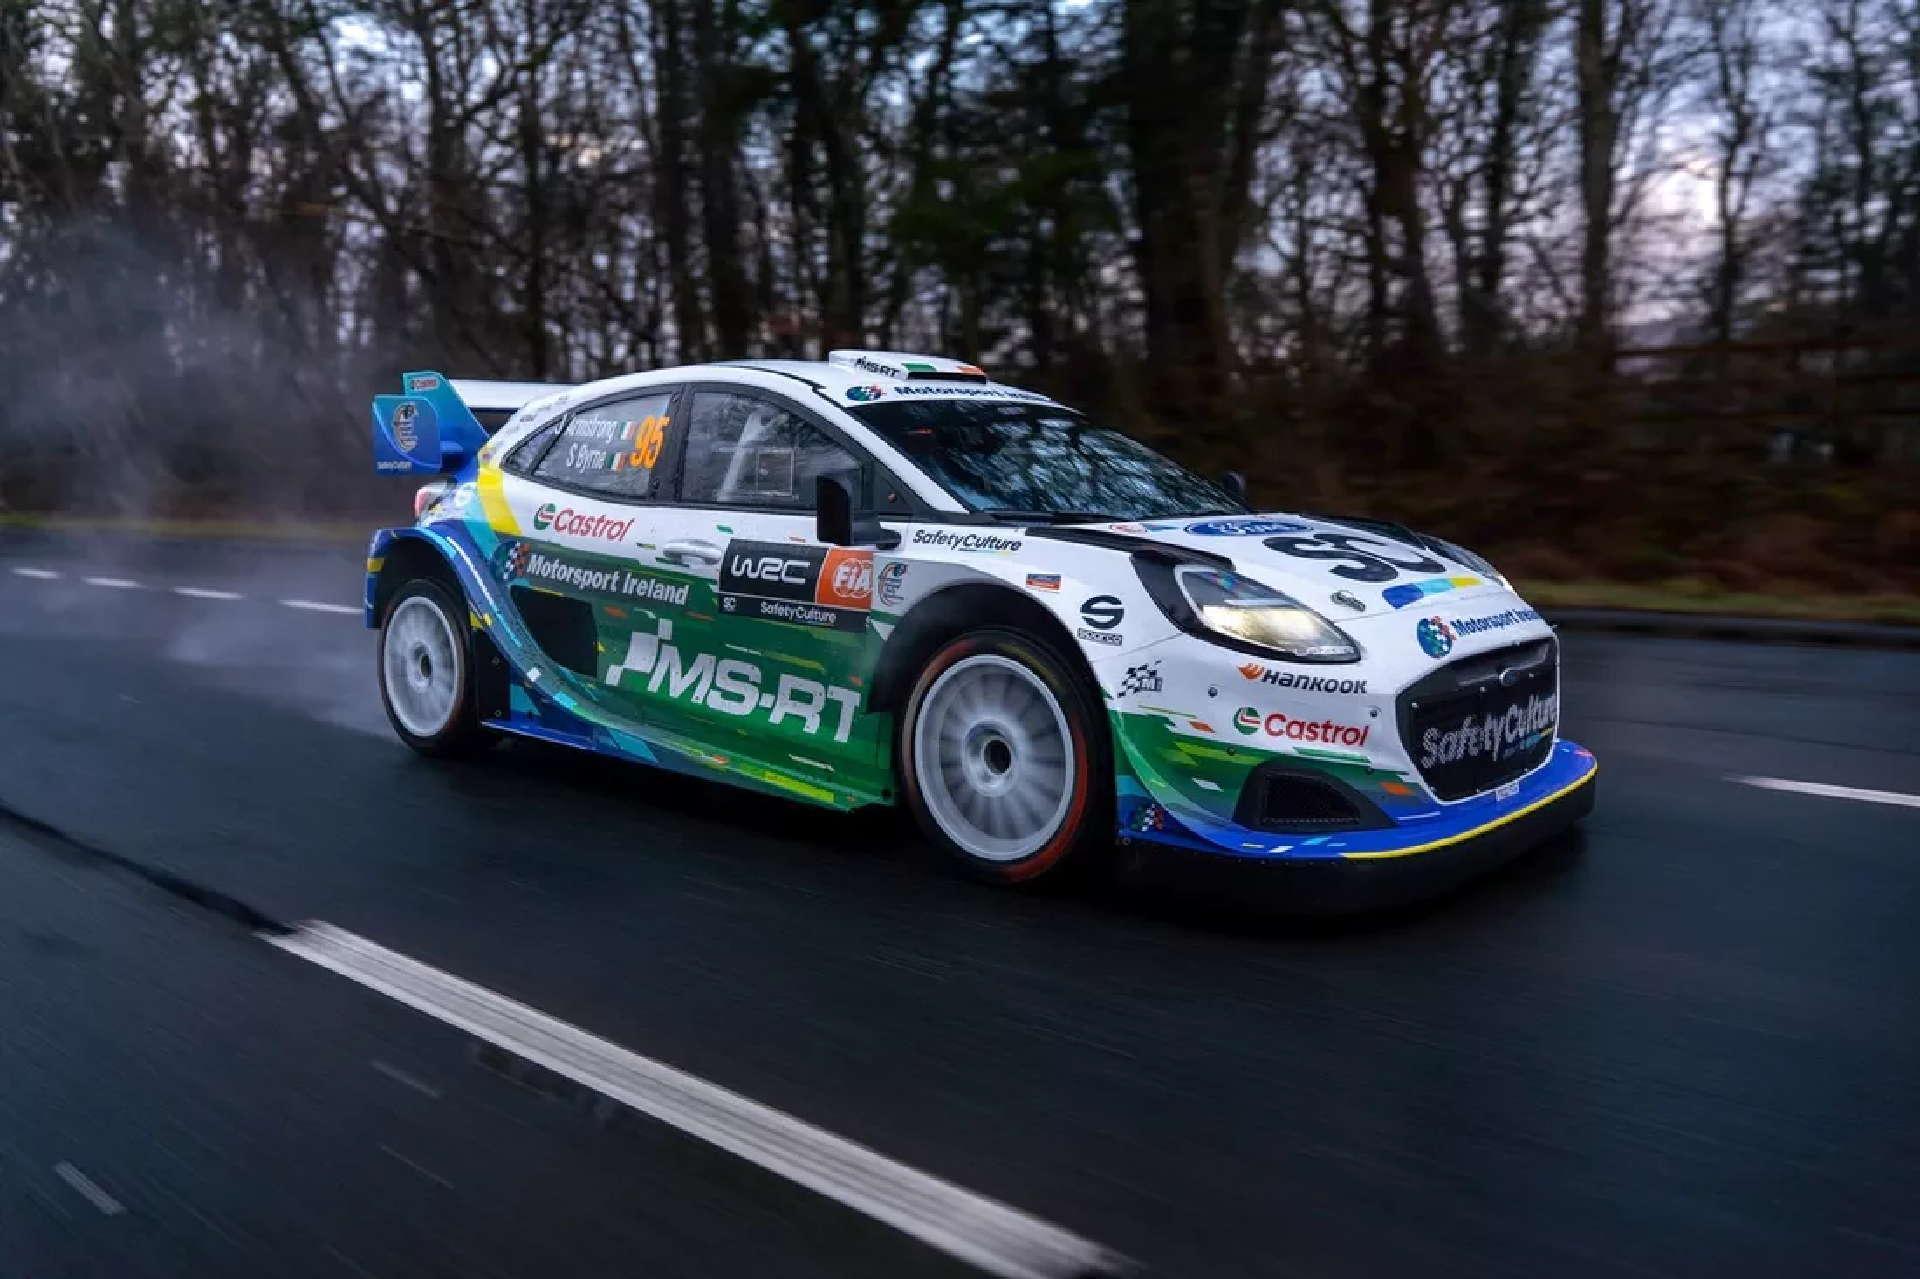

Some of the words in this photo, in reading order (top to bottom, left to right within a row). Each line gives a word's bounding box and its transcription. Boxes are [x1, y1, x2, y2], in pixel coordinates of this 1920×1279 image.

[566, 442, 579, 467] S
[629, 415, 670, 469] 95
[554, 508, 636, 542] Castrol
[912, 529, 1022, 551] SafetyCulture
[526, 554, 620, 593] Motorsport
[622, 572, 690, 606] Ireland
[730, 554, 812, 585] WRC
[833, 563, 873, 592] FIA
[760, 601, 837, 629] SafetyCulture
[1450, 610, 1513, 637] Motorsport
[647, 644, 861, 743] MS-RT
[1264, 713, 1370, 746] Castrol
